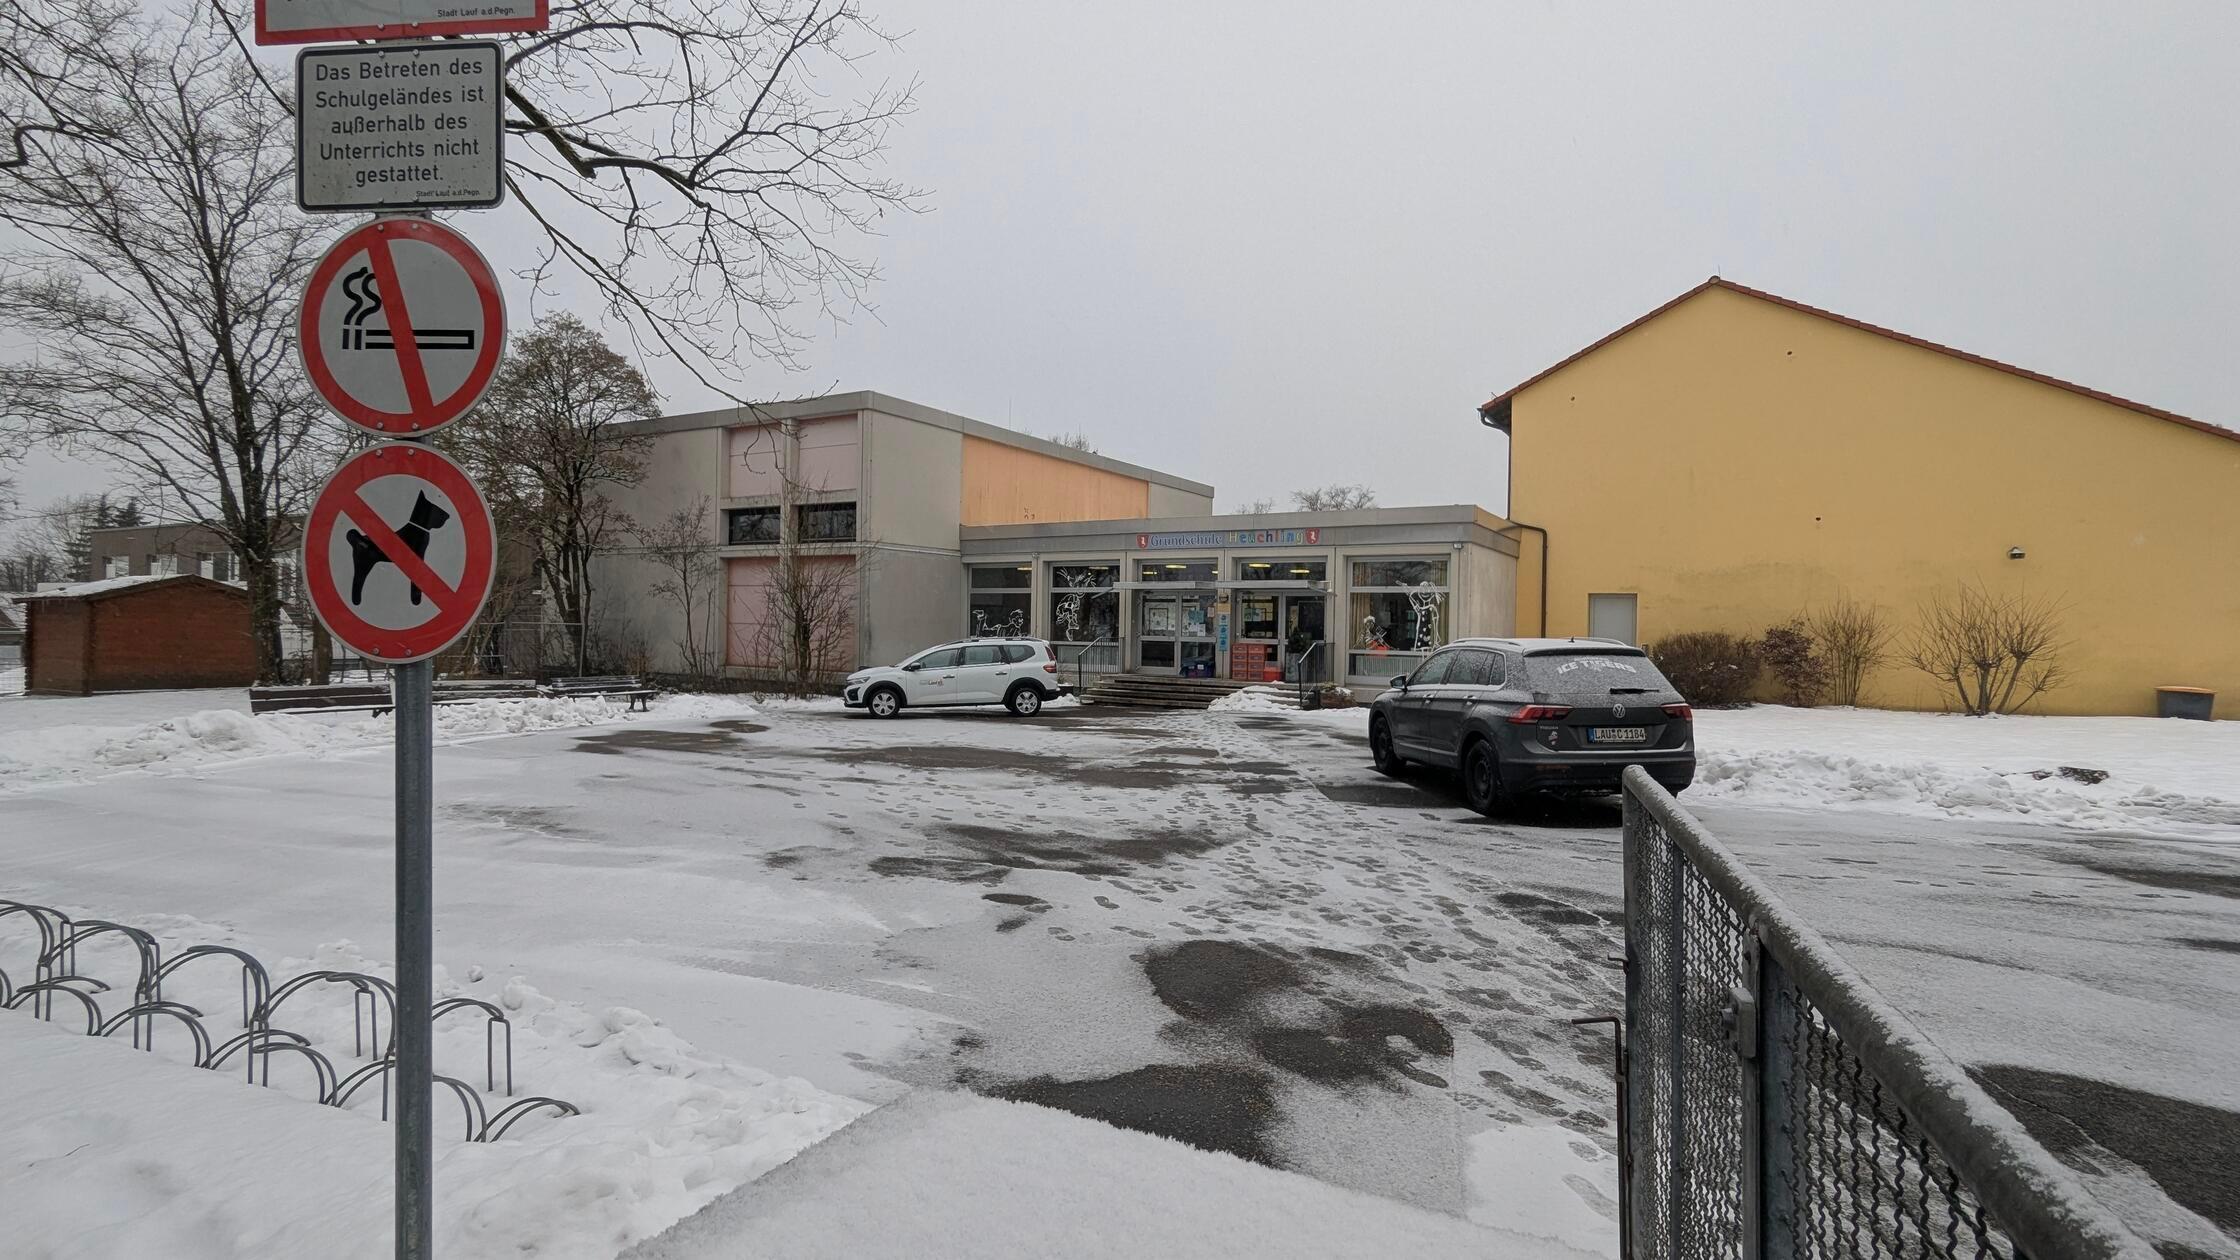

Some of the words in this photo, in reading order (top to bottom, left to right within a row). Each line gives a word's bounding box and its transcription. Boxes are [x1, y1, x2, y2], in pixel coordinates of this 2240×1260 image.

[437, 9, 458, 18] Stadt
[460, 8, 478, 16] Lauf
[316, 64, 350, 81] Das
[359, 60, 440, 80] Betreten
[449, 58, 483, 75] des
[315, 86, 452, 110] Schulgeländes
[461, 86, 484, 103] ist
[331, 114, 425, 134] außerhalb
[434, 113, 467, 130] des
[320, 141, 425, 161] Unterrichts
[434, 138, 479, 157] nicht
[356, 165, 443, 187] gestattet.
[1150, 533, 1223, 547] Grundschule
[1556, 661, 1579, 674] ICE
